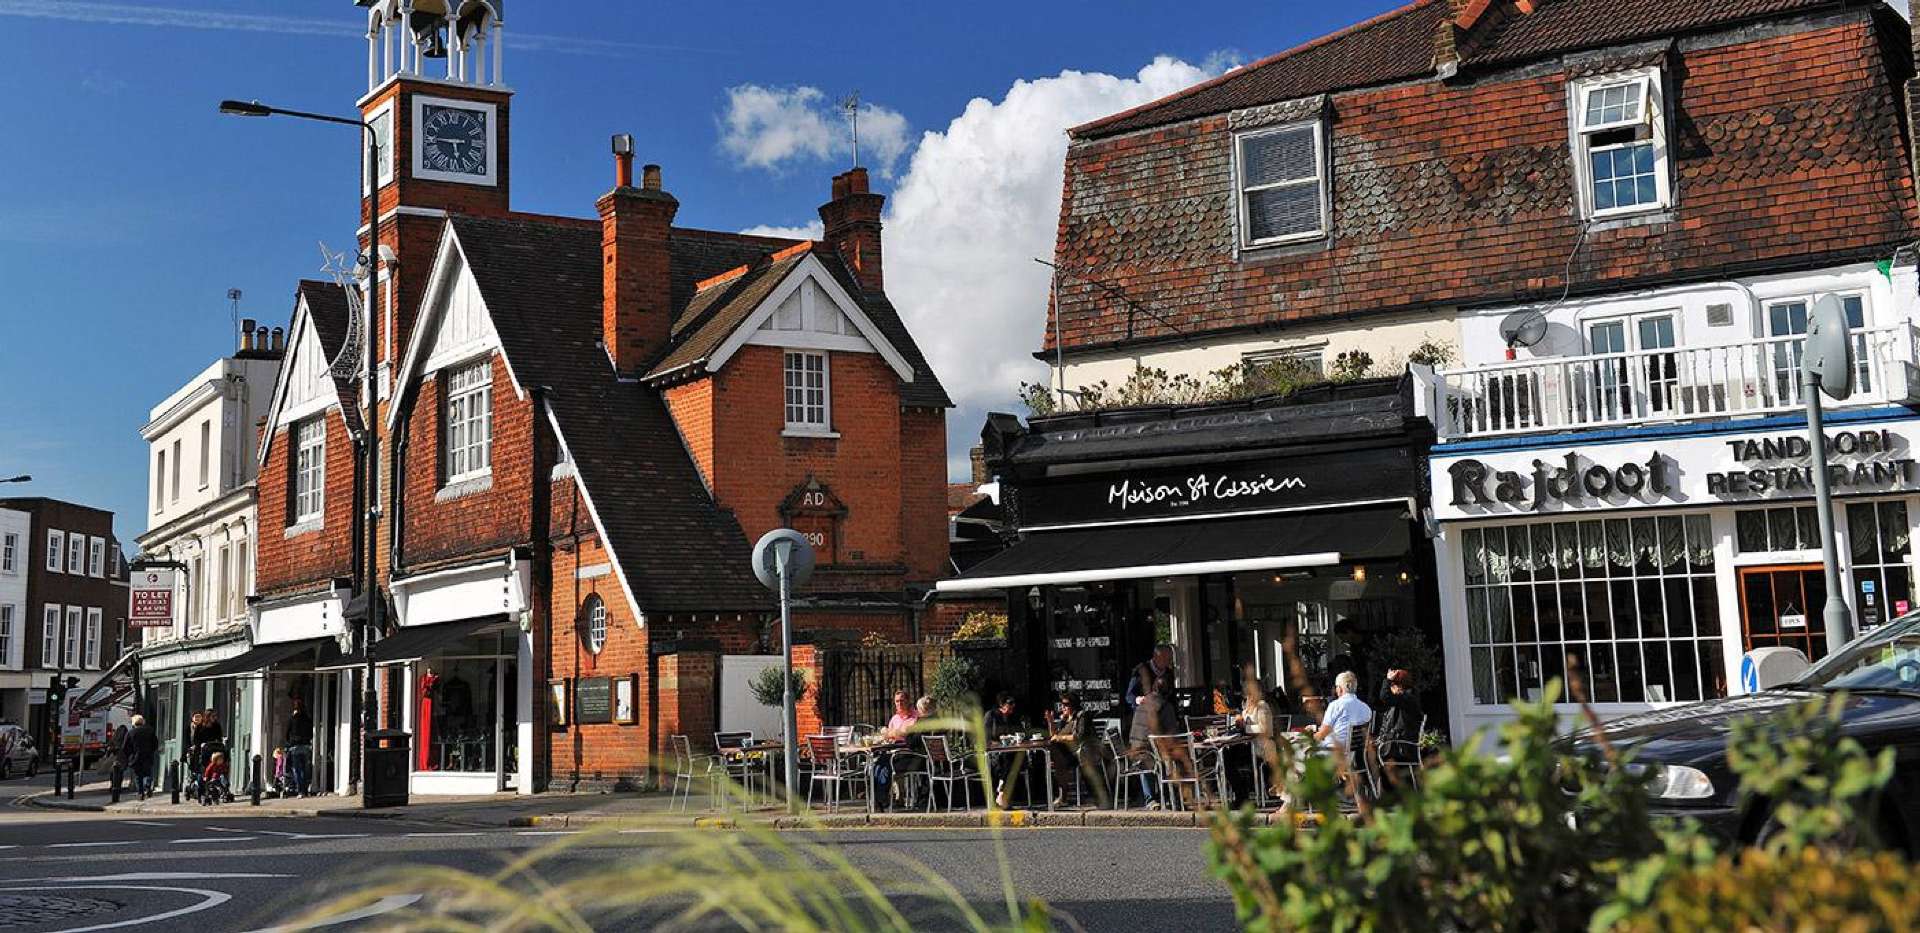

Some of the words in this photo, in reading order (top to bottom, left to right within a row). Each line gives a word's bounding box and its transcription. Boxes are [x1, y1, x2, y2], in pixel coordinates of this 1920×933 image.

[1107, 480, 1182, 510] Maison
[1214, 474, 1306, 499] Cassien
[1446, 450, 1665, 511] Rajdoot
[803, 492, 824, 506] AD
[134, 591, 148, 599] TO
